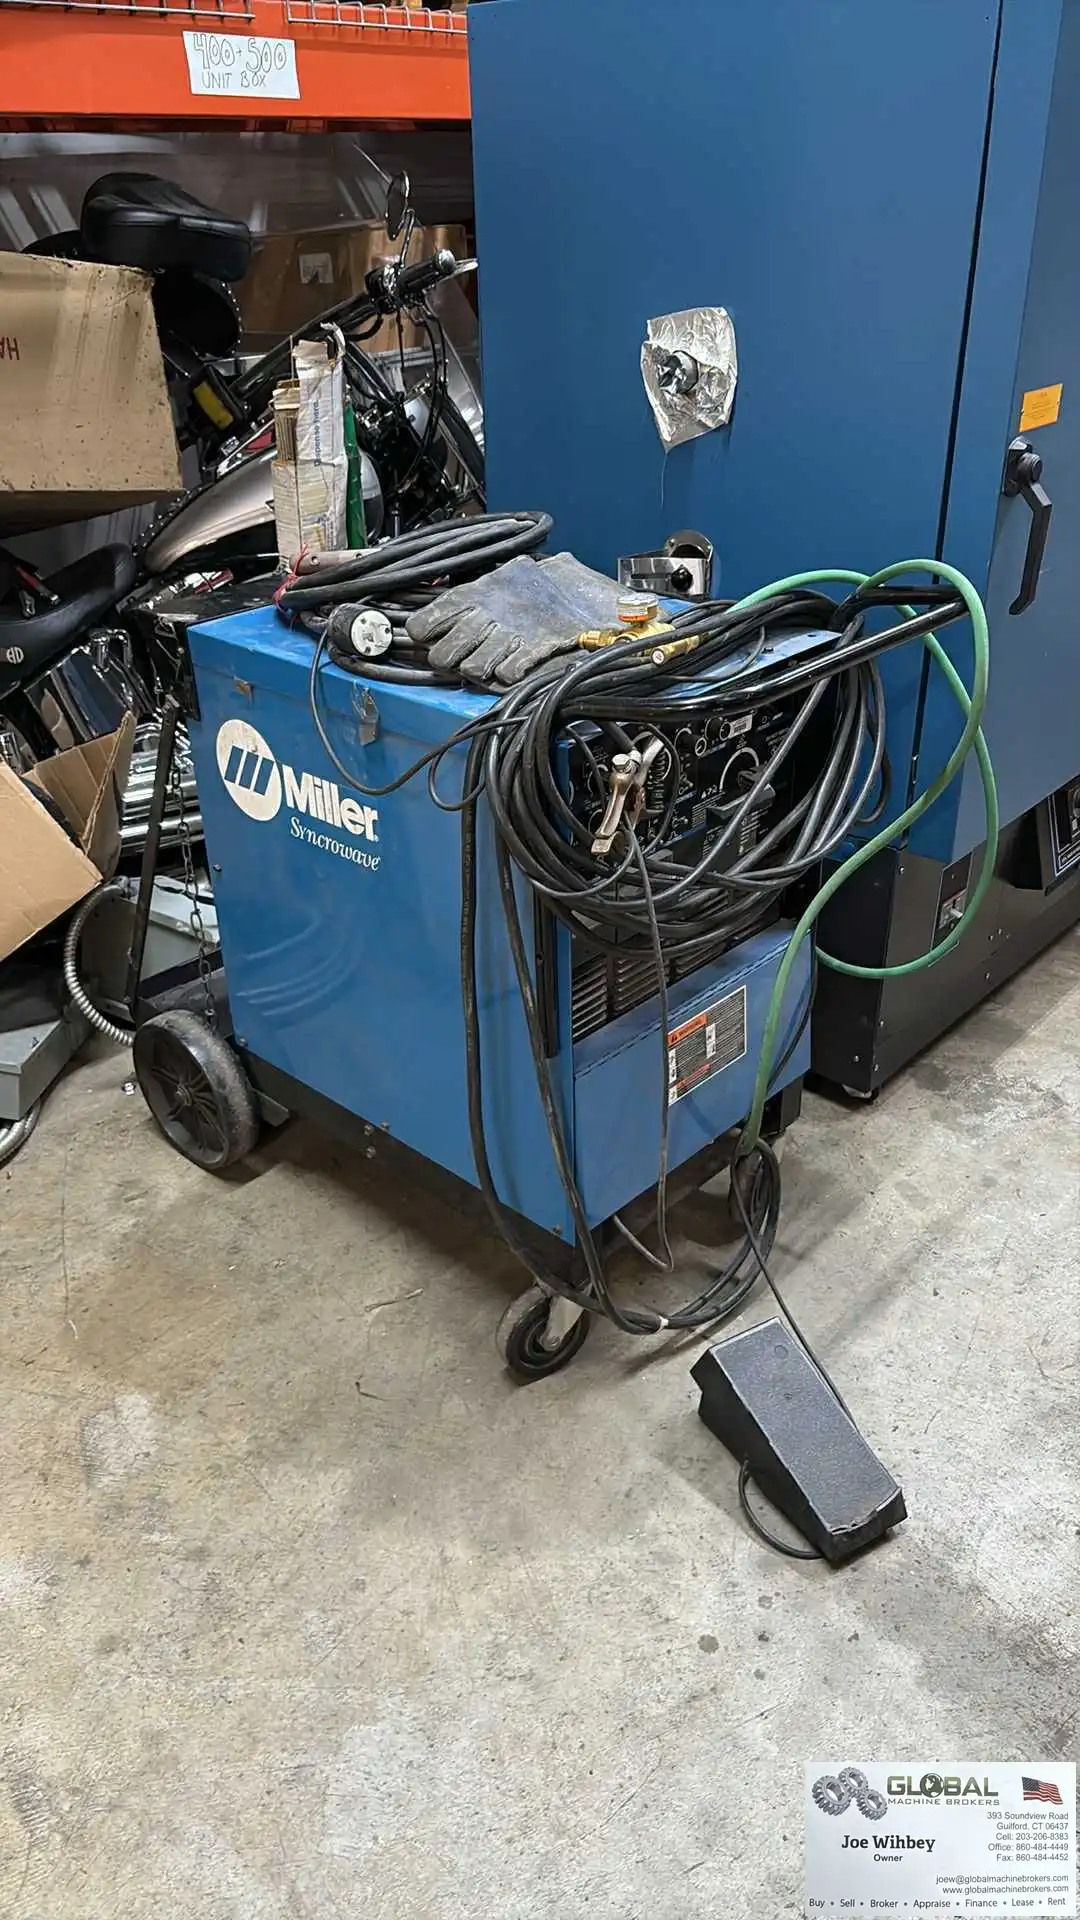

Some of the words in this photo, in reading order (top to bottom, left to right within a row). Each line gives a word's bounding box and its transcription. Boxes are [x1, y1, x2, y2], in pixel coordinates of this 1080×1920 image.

[193, 33, 235, 69] 400
[246, 37, 287, 73] 500
[201, 71, 232, 88] UNIT
[240, 70, 266, 88] BOX
[282, 764, 379, 842] Miller
[290, 816, 381, 871] Syncrowave
